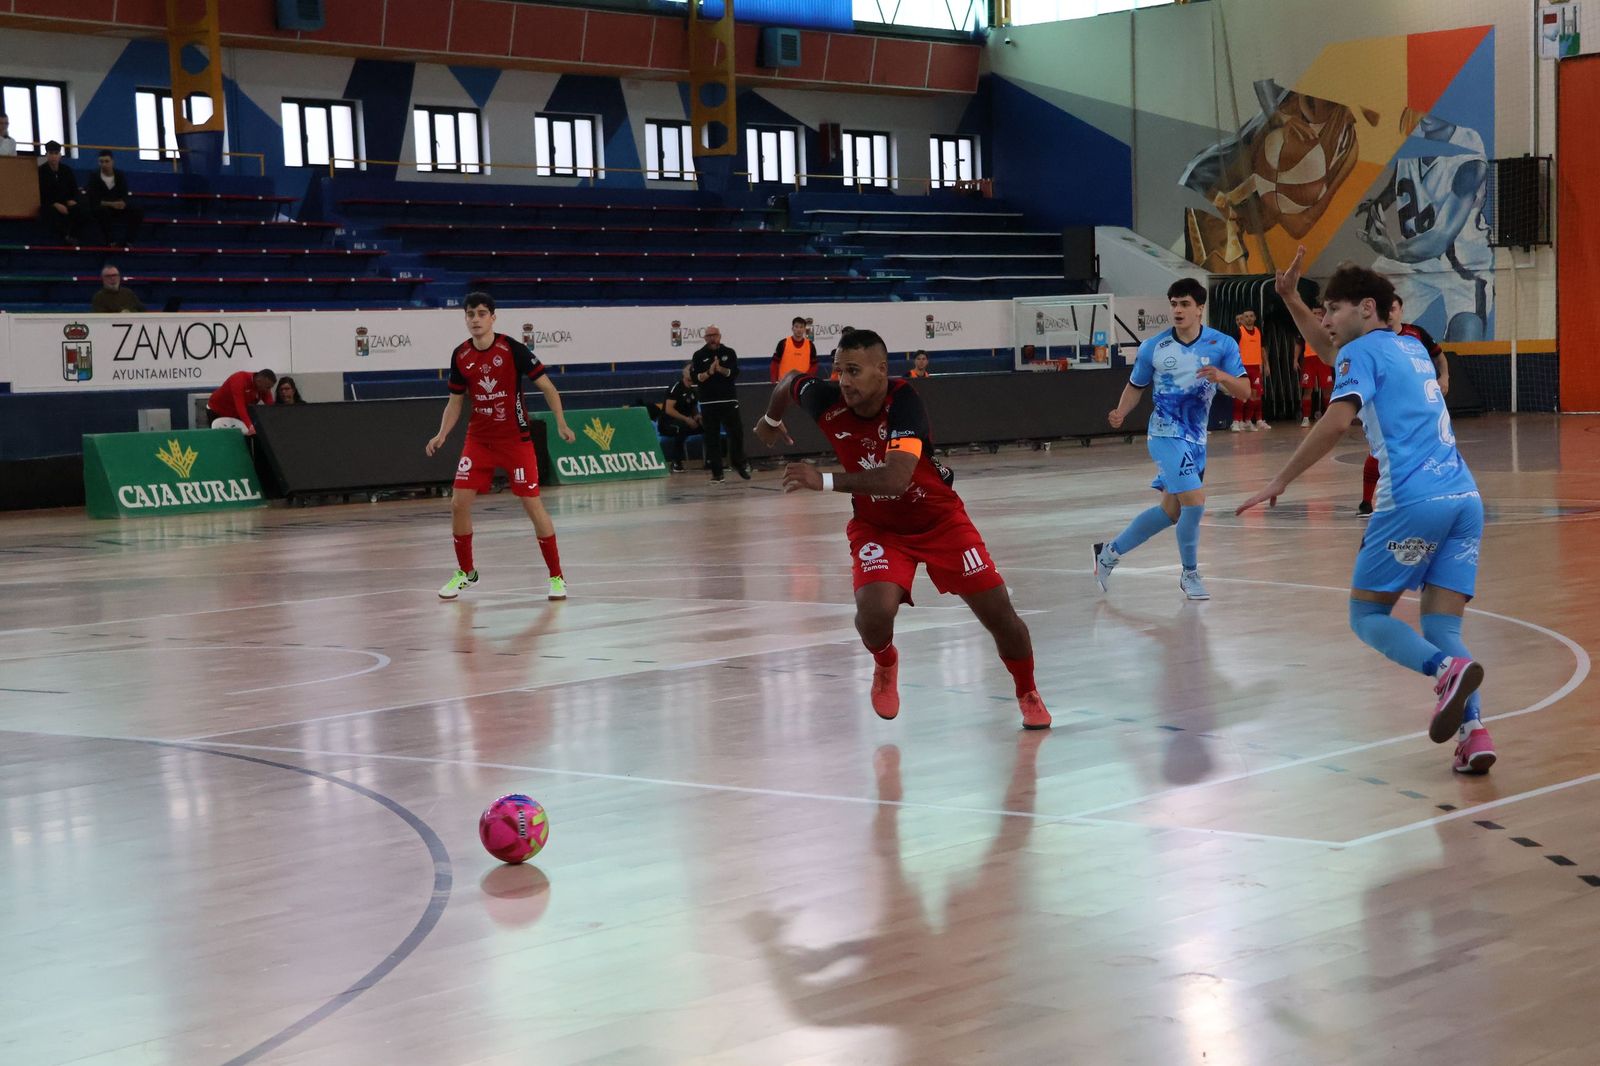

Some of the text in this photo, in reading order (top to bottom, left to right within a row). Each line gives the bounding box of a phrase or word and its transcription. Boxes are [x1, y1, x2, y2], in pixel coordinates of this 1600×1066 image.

[683, 327, 706, 339] ZAMO
[936, 320, 963, 332] ZAMORA
[112, 322, 253, 361] ZAMORA
[370, 334, 412, 348] ZAMORA
[536, 330, 573, 344] ZAMORA
[112, 367, 202, 381] AYUNTAMIENTO
[557, 451, 665, 476] CAJA RURAL
[118, 478, 262, 508] CAJA RURAL
